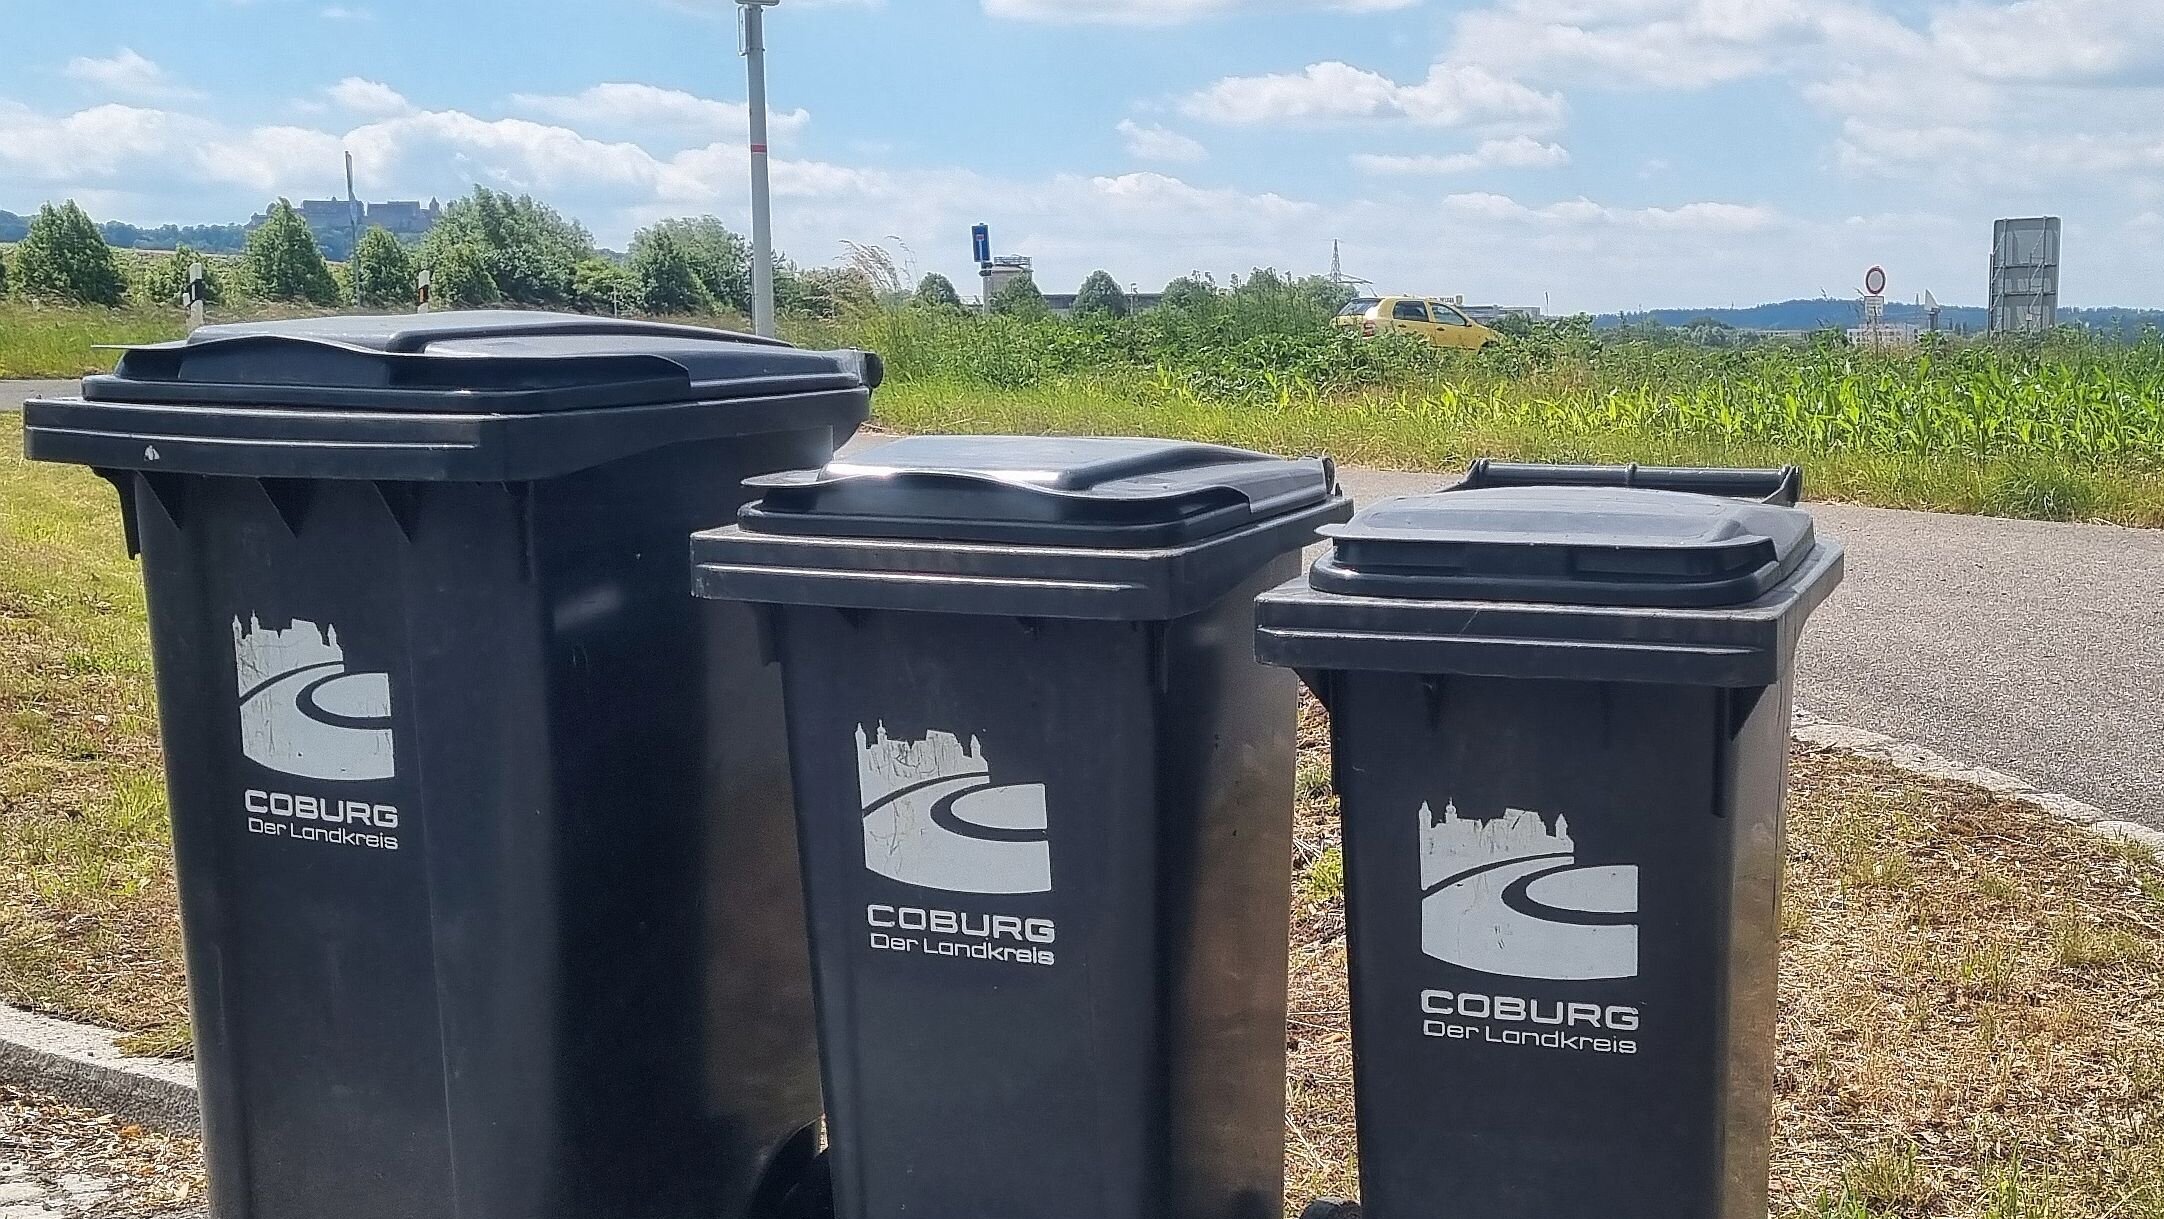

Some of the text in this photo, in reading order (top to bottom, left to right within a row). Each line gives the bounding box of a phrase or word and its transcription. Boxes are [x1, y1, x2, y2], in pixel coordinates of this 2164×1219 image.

[244, 789, 399, 829] COBURG
[248, 817, 399, 850] Der Landkreis
[867, 904, 1056, 944] COBURG
[870, 932, 1055, 966] Der Landkreis
[1420, 989, 1639, 1031] COBURG
[1423, 1019, 1638, 1054] Der Landkreis
